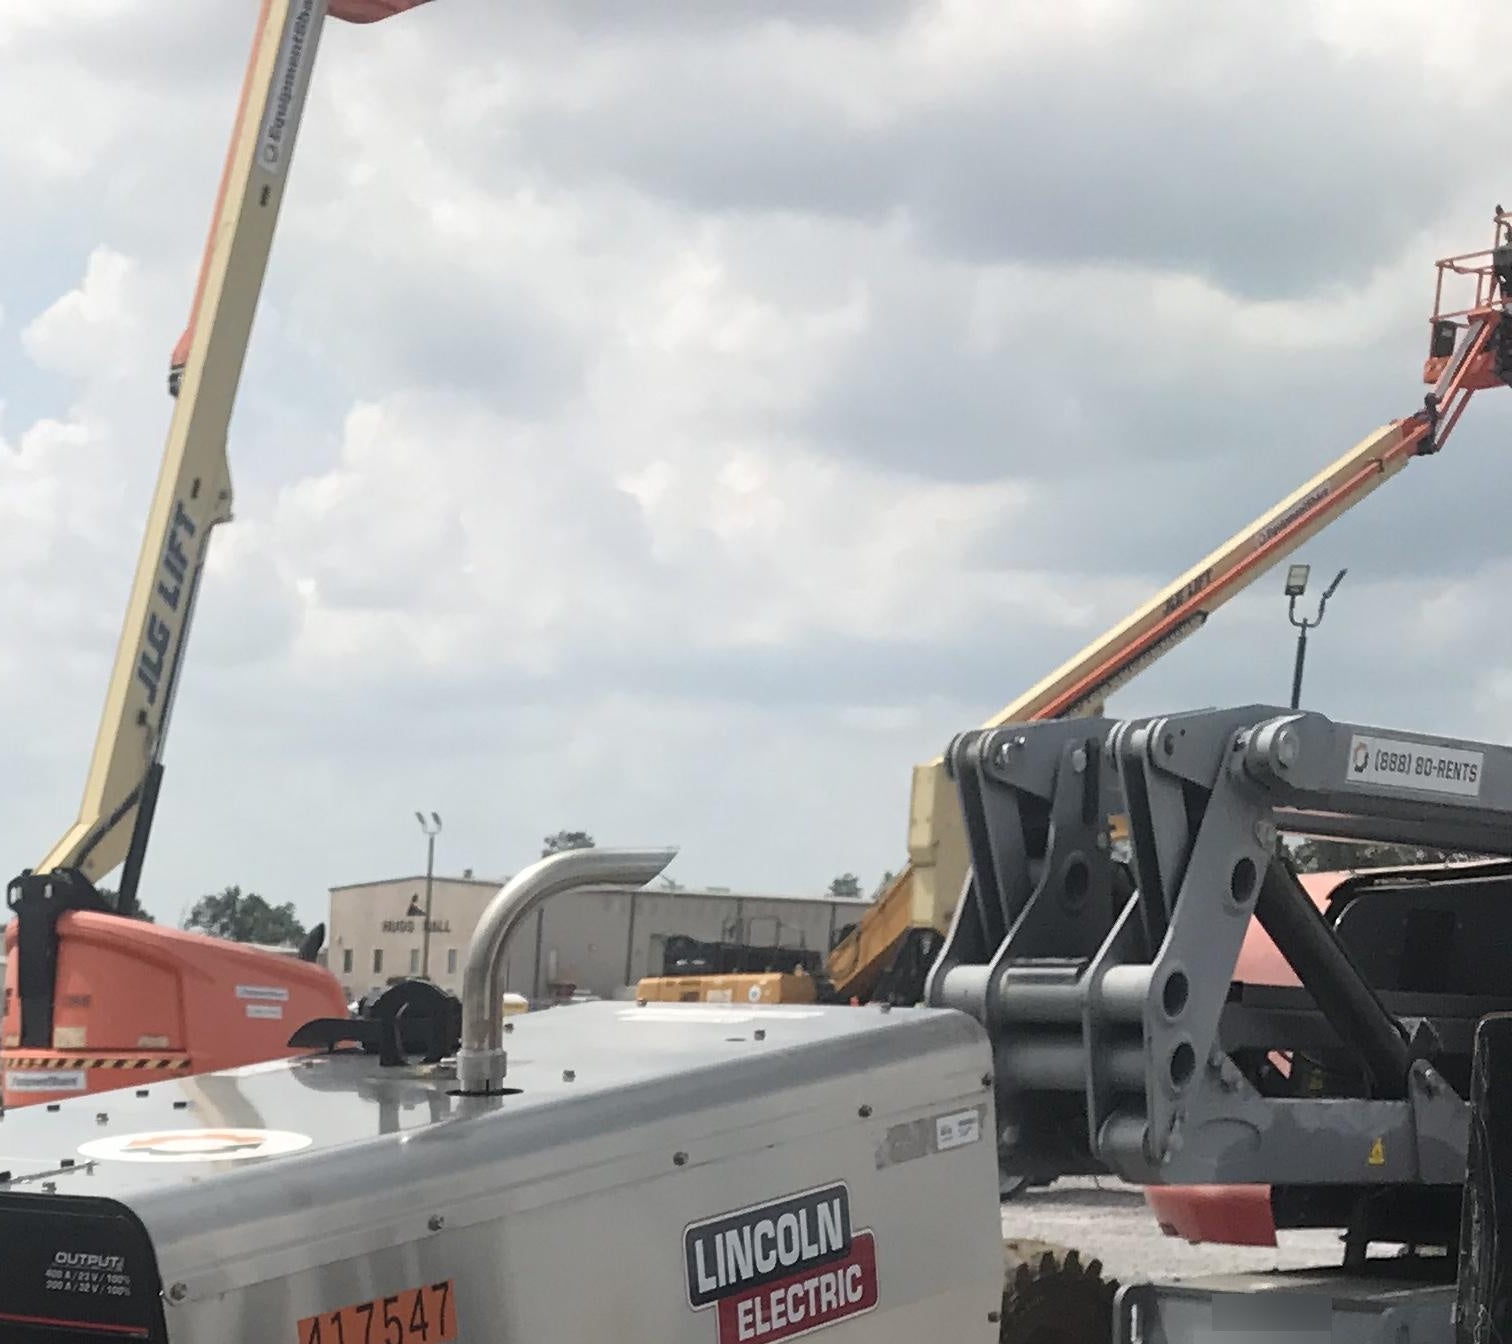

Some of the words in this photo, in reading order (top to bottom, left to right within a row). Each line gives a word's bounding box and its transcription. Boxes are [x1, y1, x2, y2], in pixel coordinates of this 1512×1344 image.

[138, 611, 170, 704] JLG
[157, 500, 196, 611] LIFT
[1374, 749, 1412, 775] (888)
[1415, 756, 1478, 783] 80-RENTS
[694, 1198, 845, 1294] LINCOLN
[737, 1264, 864, 1342] ELECTRIC
